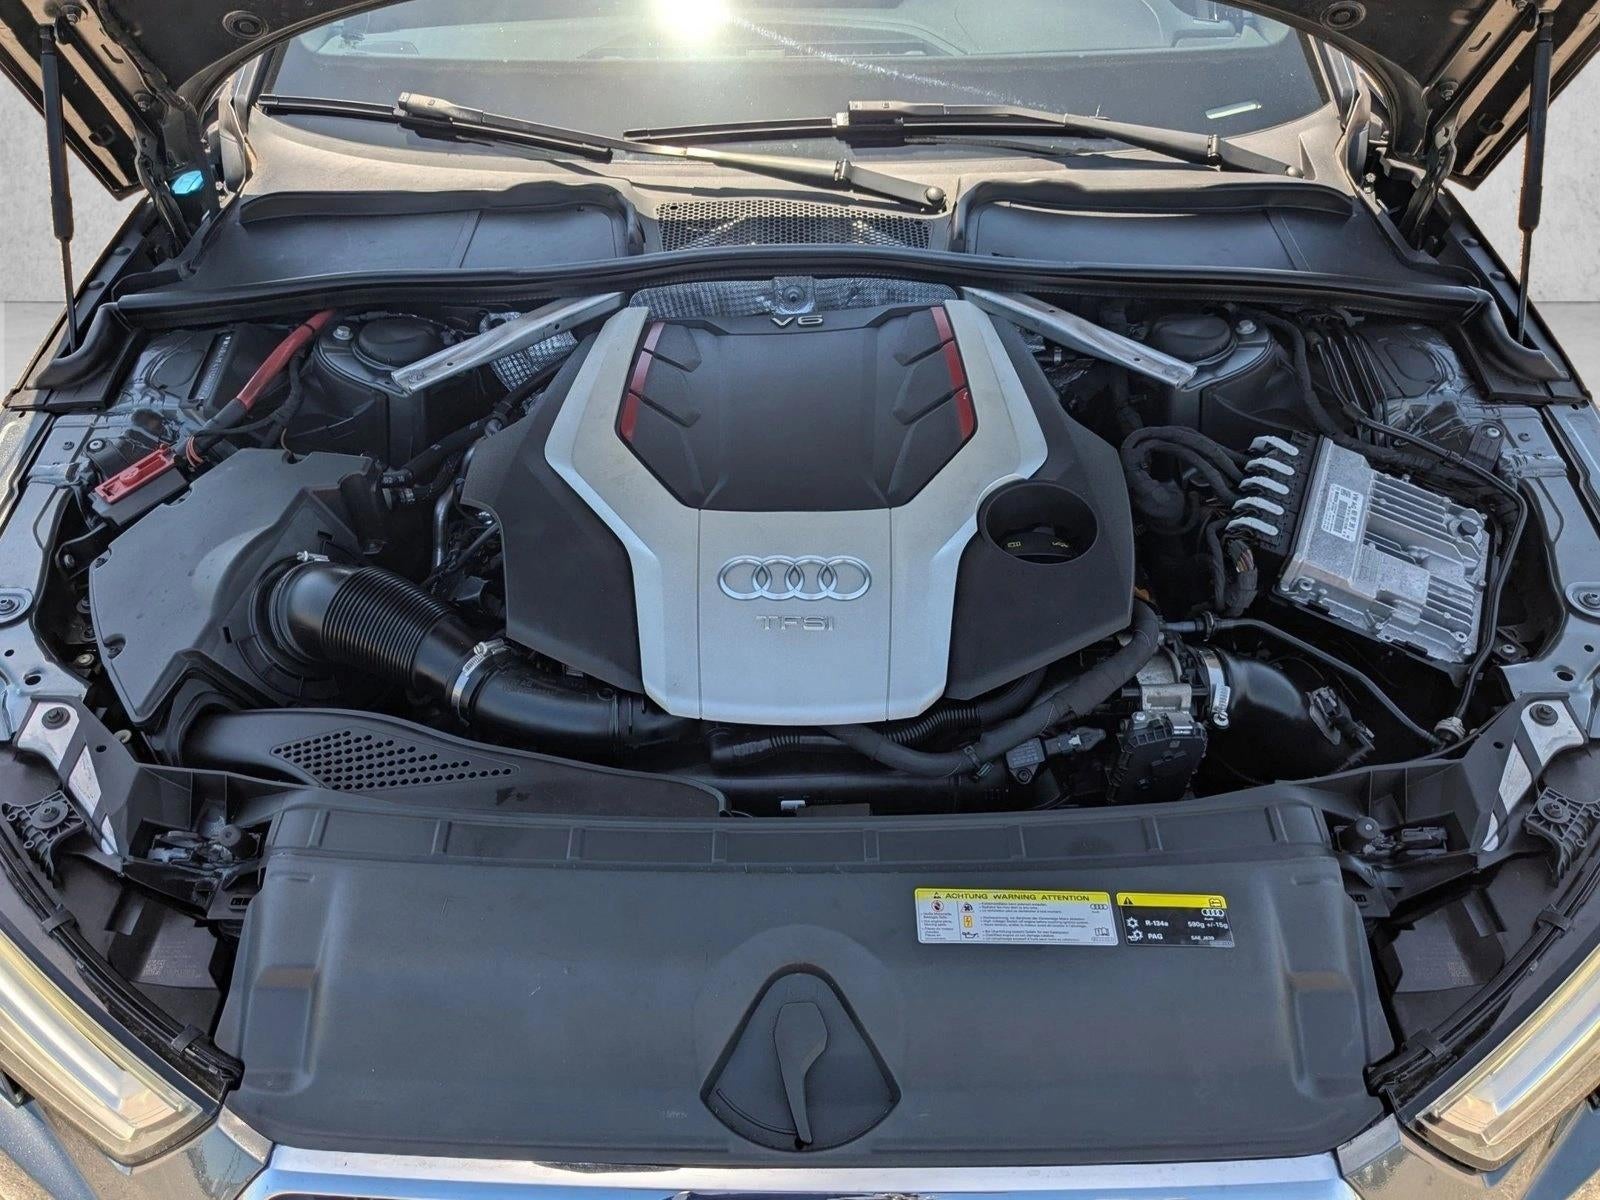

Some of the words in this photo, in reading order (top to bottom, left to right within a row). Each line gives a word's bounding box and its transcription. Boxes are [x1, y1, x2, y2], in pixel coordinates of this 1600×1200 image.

[770, 314, 823, 327] V6
[756, 615, 835, 632] TFSI
[945, 892, 988, 900] ACHTUNG
[993, 893, 1037, 901] WARNING
[1041, 894, 1090, 902] ATTENTION
